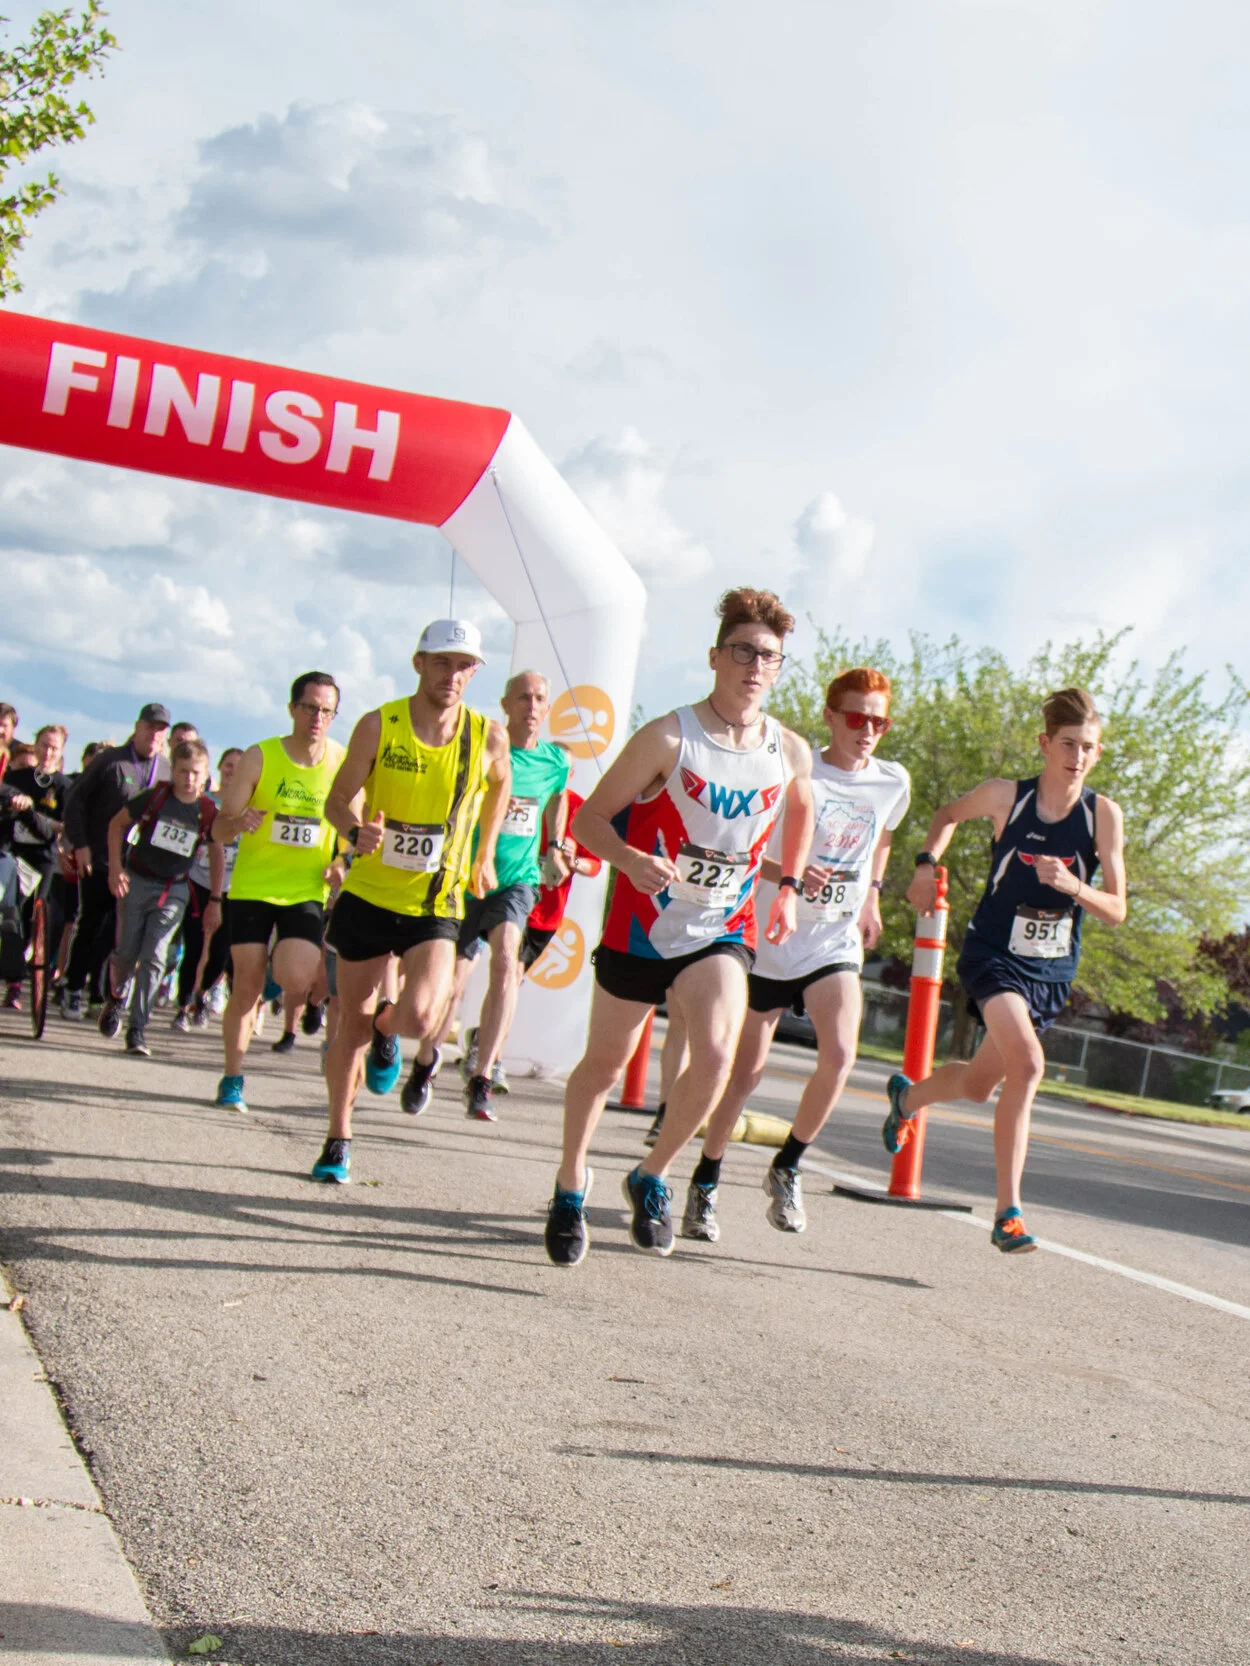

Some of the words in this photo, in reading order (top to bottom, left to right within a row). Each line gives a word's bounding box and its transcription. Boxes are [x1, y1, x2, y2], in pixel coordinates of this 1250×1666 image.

[41, 340, 401, 483] FINISH
[708, 781, 760, 820] WX
[161, 825, 188, 844] 732
[280, 825, 312, 843] 218
[823, 832, 861, 849] 2018
[393, 834, 434, 857] 220
[686, 860, 736, 888] 222
[1023, 921, 1060, 941] 951
